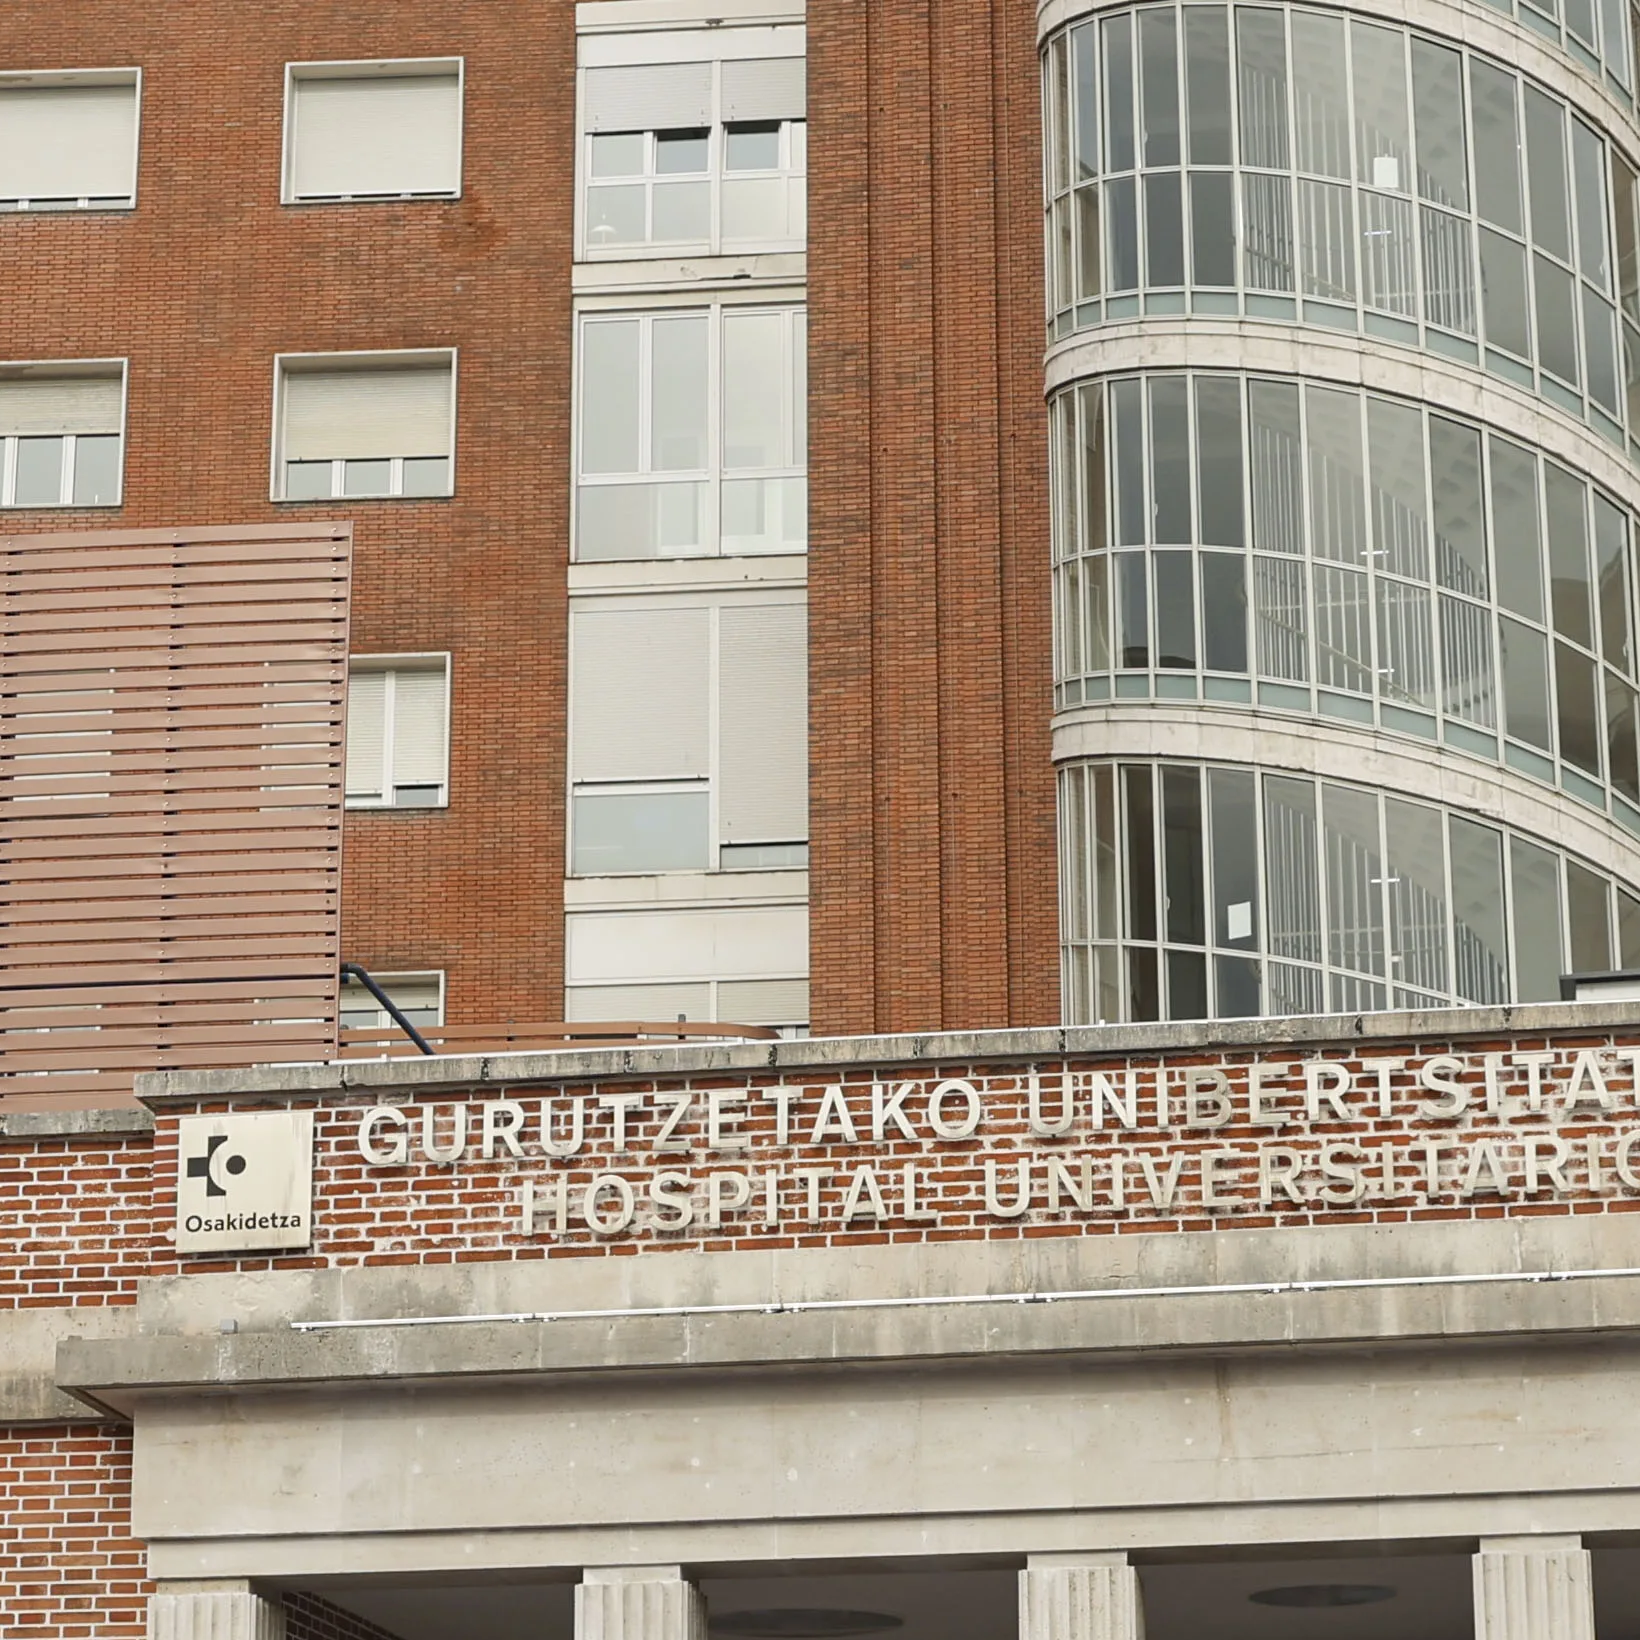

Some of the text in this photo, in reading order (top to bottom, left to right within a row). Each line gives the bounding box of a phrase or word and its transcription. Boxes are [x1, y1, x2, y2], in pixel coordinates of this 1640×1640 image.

[359, 1078, 982, 1165] GURUTZETAKO
[185, 1212, 301, 1232] Osakidetza
[522, 1162, 939, 1237] HOSPITAL
